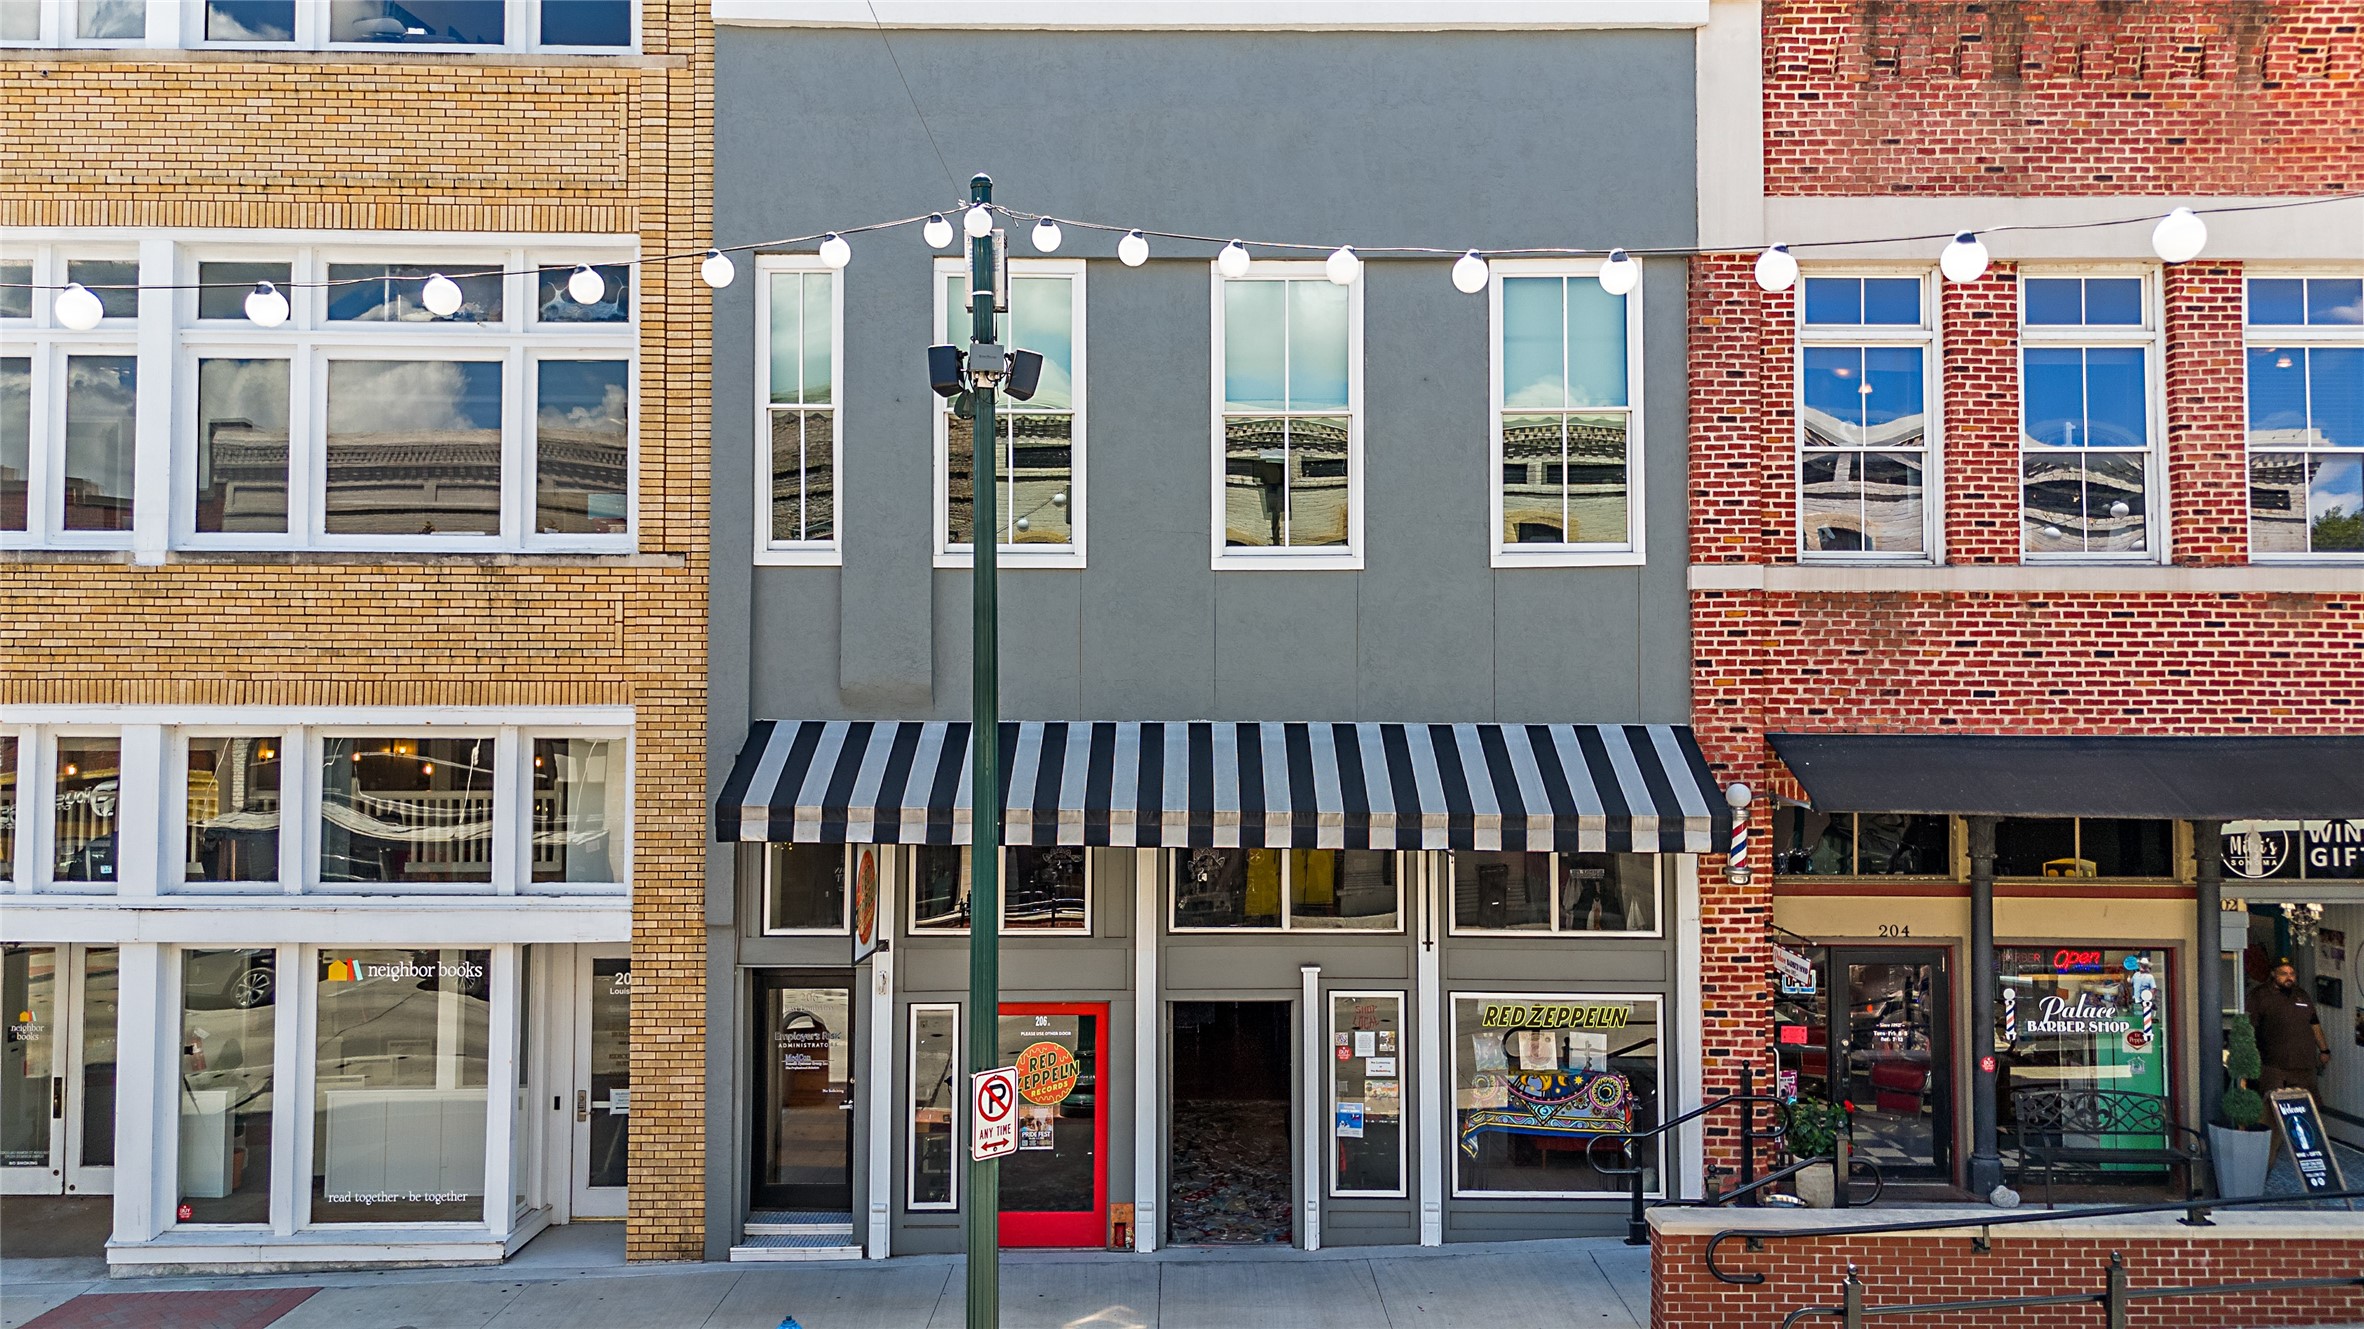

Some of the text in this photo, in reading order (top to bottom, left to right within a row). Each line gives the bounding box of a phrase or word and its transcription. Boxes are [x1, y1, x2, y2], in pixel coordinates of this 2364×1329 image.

[2310, 847, 2364, 867] GIF
[1878, 924, 1910, 938] 204
[2053, 950, 2102, 970] Open
[368, 961, 483, 982] neighbor books
[2039, 993, 2116, 1024] Palace
[11, 1022, 45, 1034] neighbor
[2027, 1020, 2130, 1033] BARBER SHOP
[16, 1032, 40, 1041] books
[1028, 1051, 1058, 1073] RED
[1031, 1080, 1068, 1098] RECORDS
[979, 1123, 1012, 1140] ANY TIME
[328, 1190, 468, 1206] read together be together
